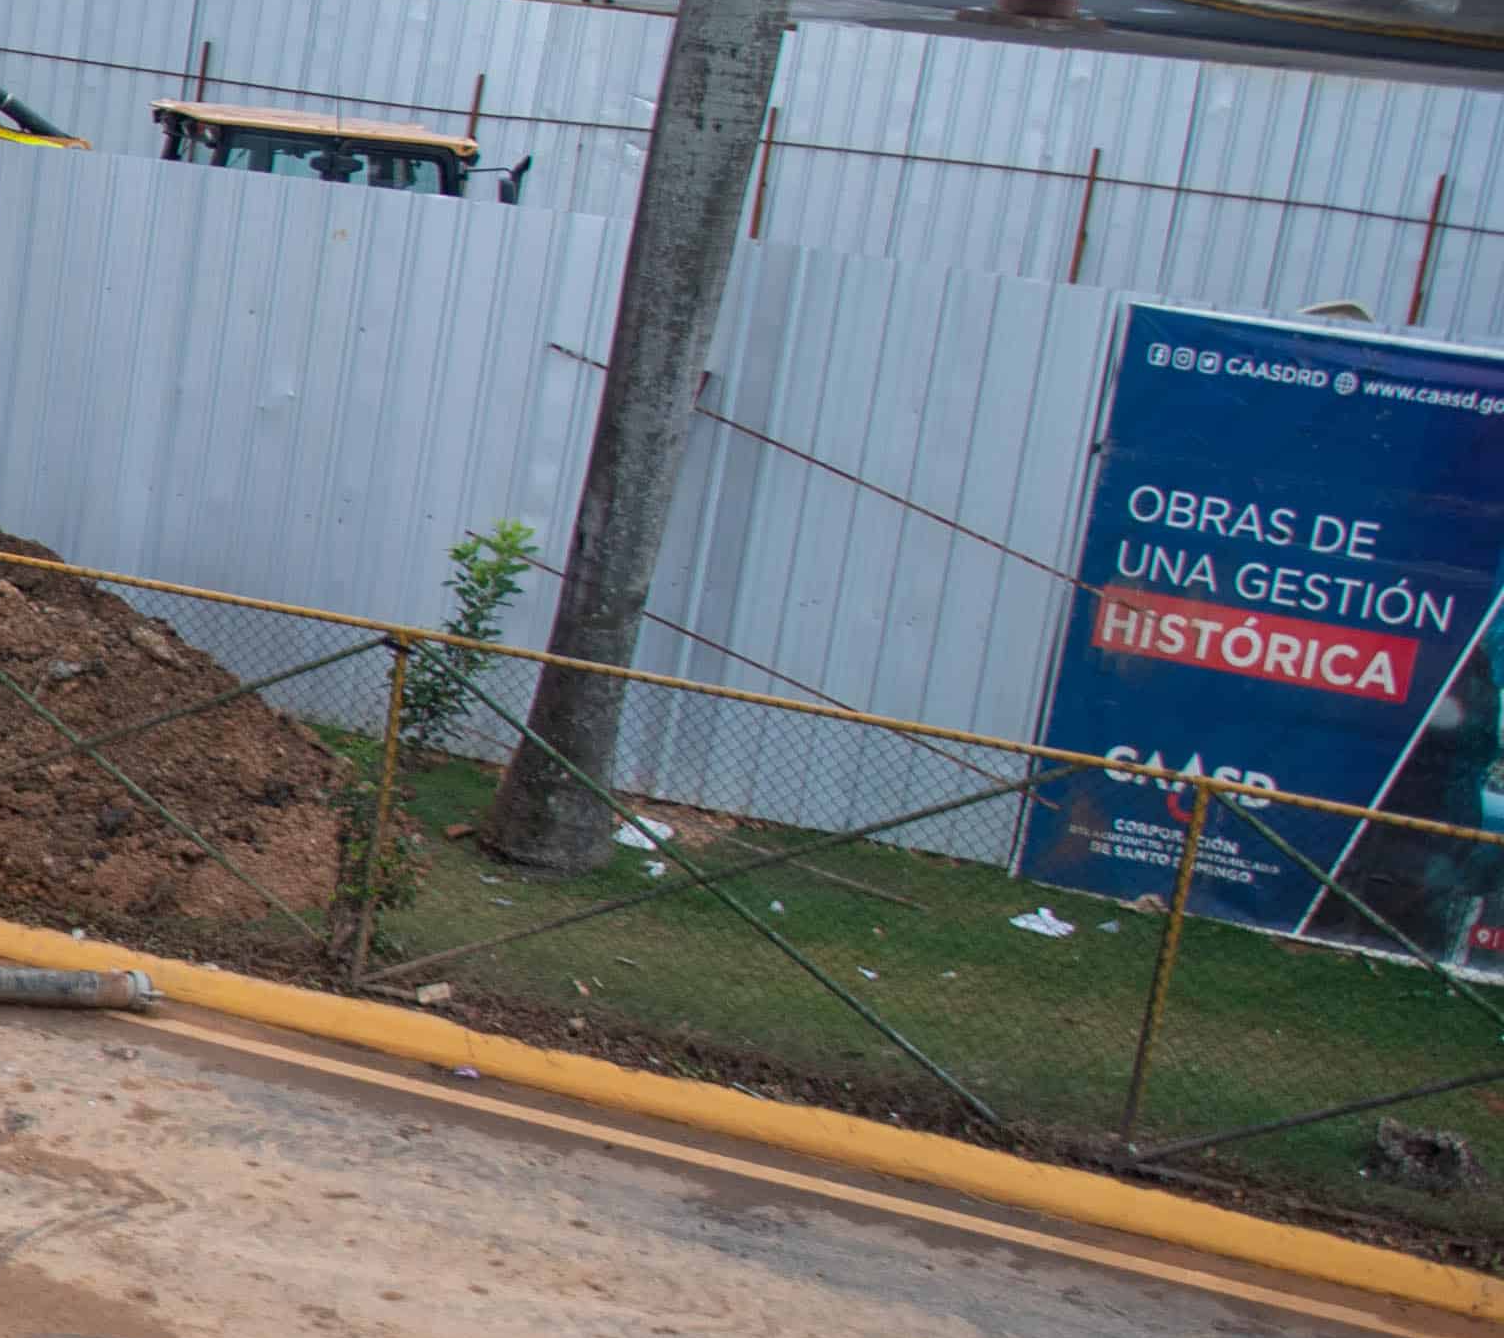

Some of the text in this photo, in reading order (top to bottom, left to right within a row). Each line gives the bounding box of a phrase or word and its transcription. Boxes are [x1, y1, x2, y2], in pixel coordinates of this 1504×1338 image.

[1224, 357, 1328, 388] CAASDRD
[1128, 485, 1381, 560] OBRAS DE
[1117, 540, 1455, 632] UNA GESTIÓN
[1102, 601, 1396, 694] HISTÓRICA
[1113, 818, 1240, 855] CORPORCIÓN
[1114, 844, 1172, 867] SANTO
